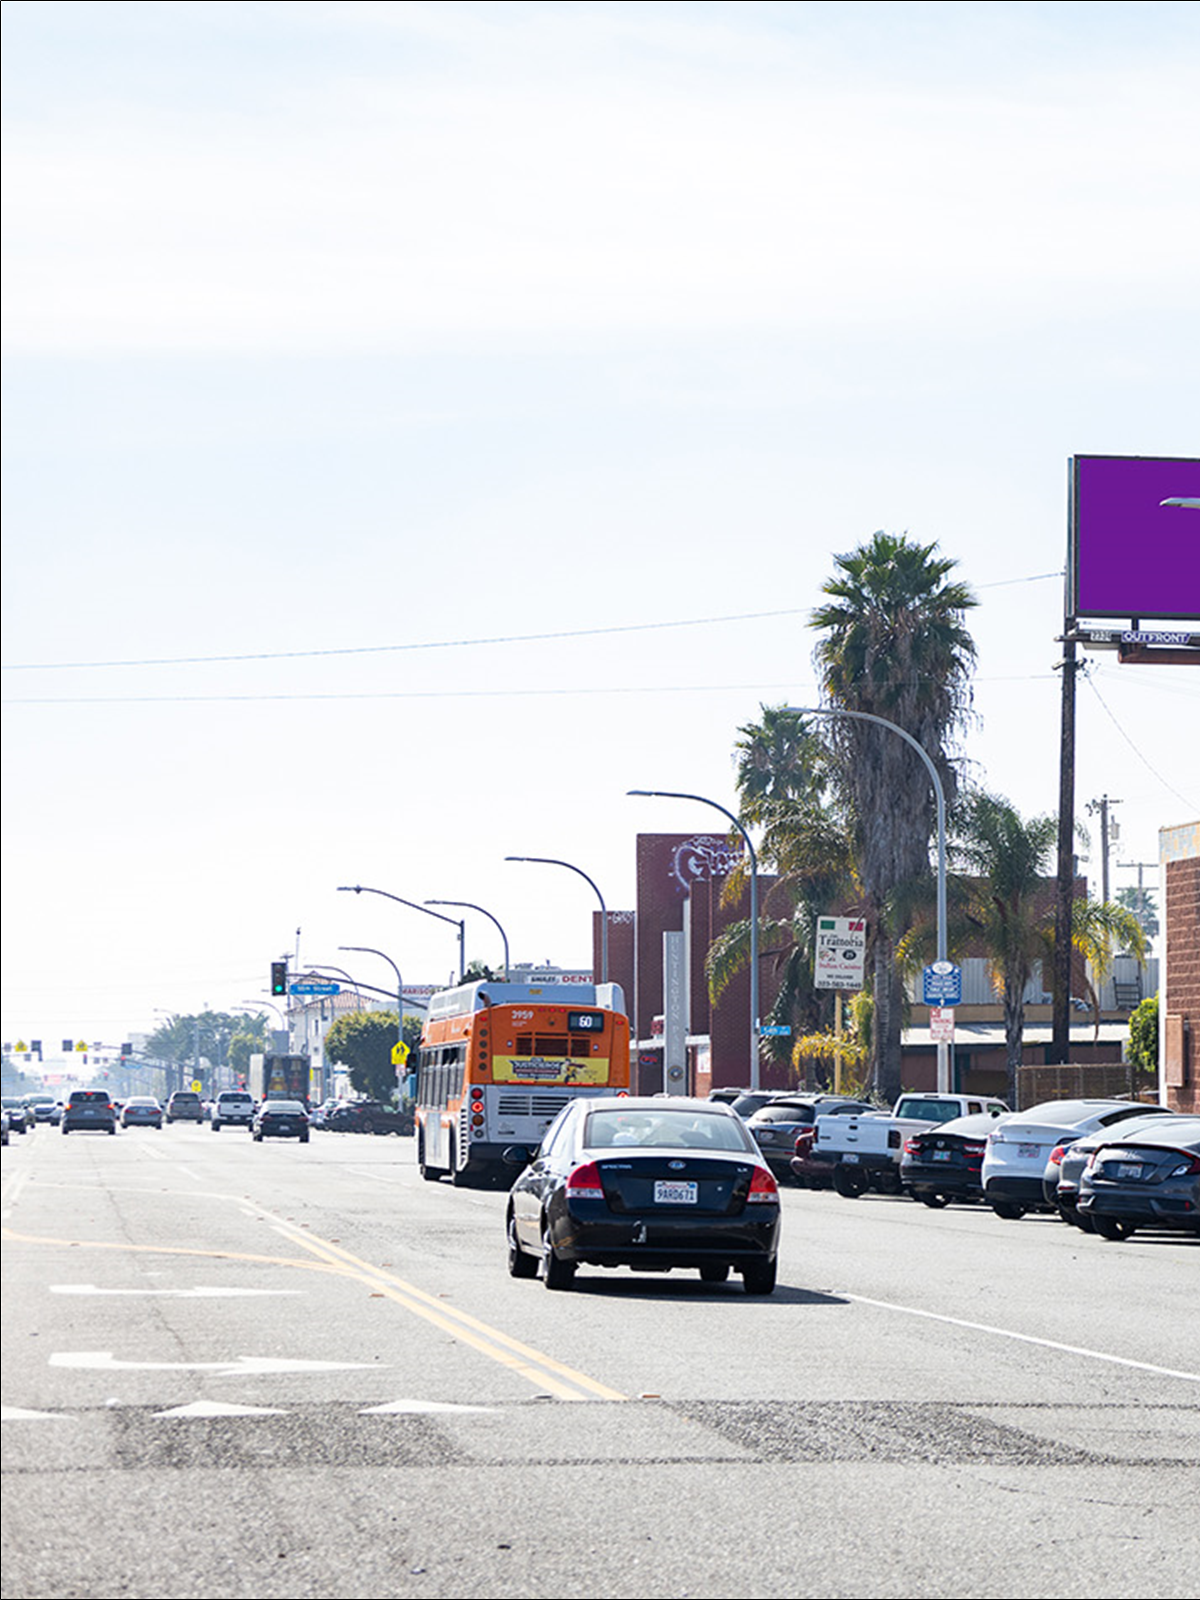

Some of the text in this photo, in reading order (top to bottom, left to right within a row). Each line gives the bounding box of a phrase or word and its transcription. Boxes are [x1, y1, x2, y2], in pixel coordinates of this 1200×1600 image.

[1123, 632, 1188, 643] OUTFRONT
[819, 934, 864, 947] Trattoria
[562, 974, 593, 984] DENT
[670, 936, 681, 1020] HUNTINGTON
[511, 1010, 534, 1020] 3959
[578, 1016, 593, 1028] 60
